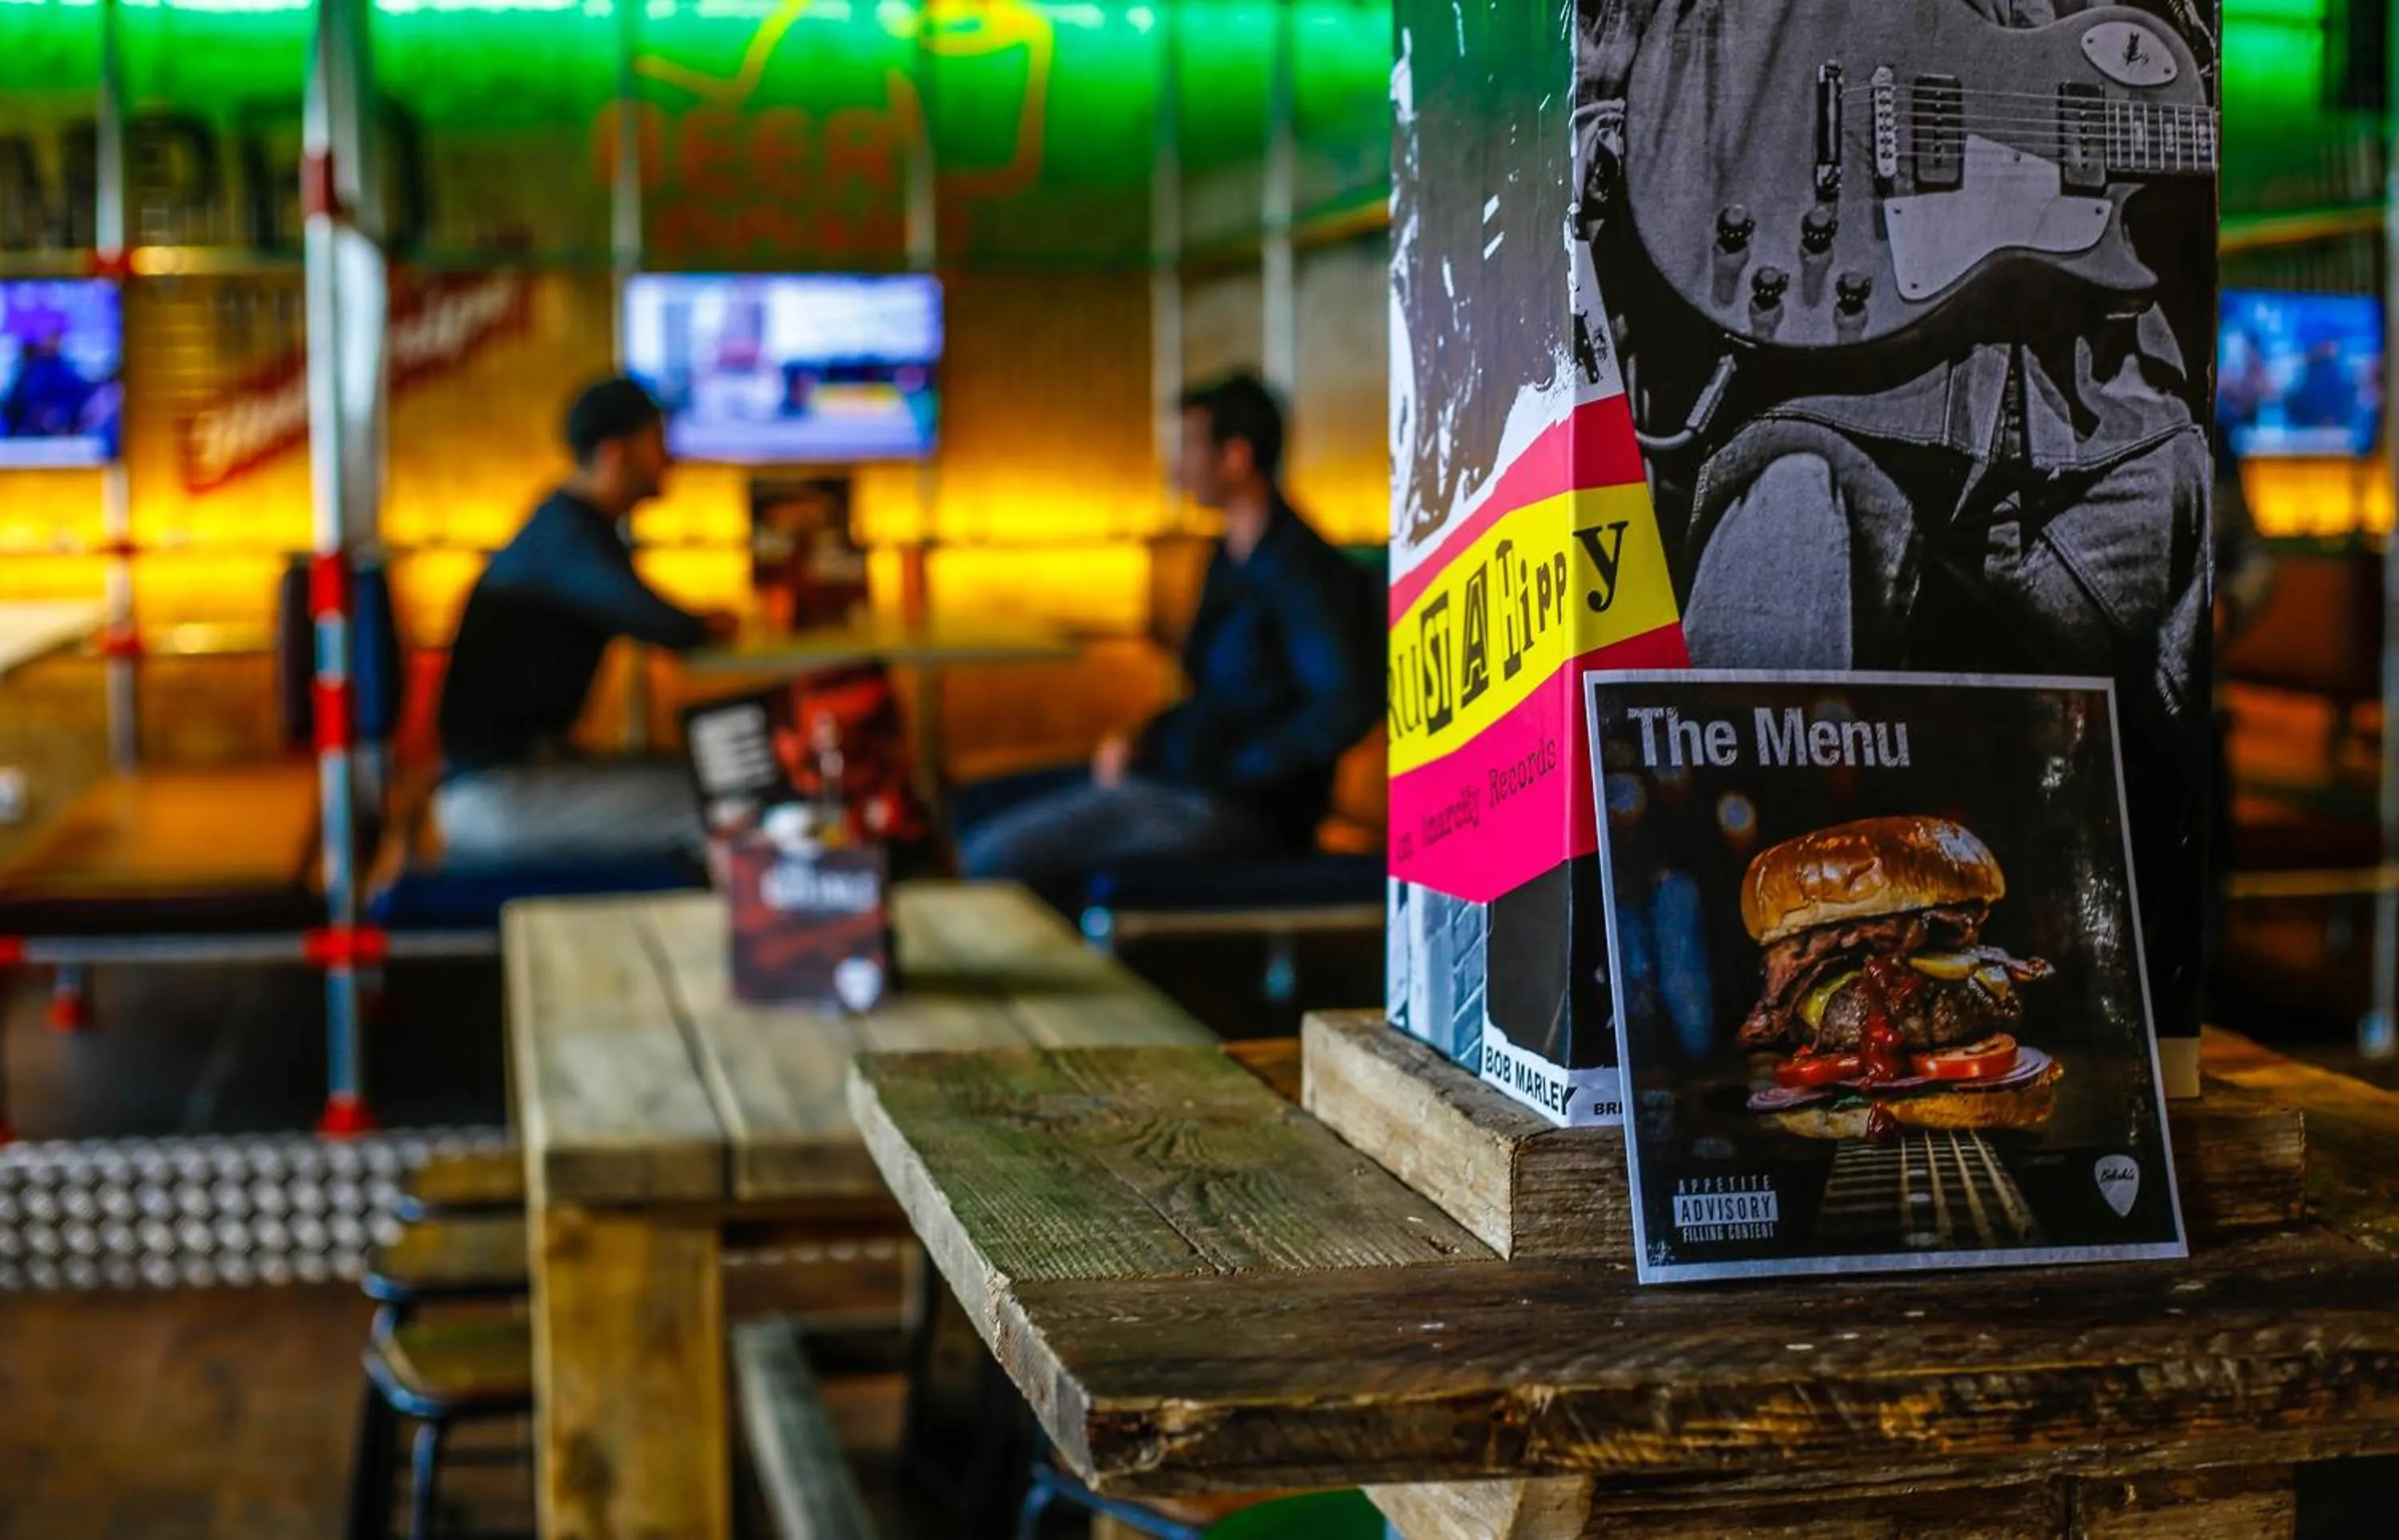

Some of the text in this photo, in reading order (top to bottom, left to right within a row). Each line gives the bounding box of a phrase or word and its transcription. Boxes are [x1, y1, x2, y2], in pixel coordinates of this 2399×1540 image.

[1462, 561, 1489, 709] A
[1627, 707, 1911, 768] The Menu
[1488, 737, 1556, 809] Records
[1485, 1045, 1578, 1115] BOB MARLEY
[1679, 1175, 1770, 1195] APPETITE
[1682, 1195, 1770, 1223] ADVISORY
[1682, 1223, 1774, 1243] FILLING CONTENT
